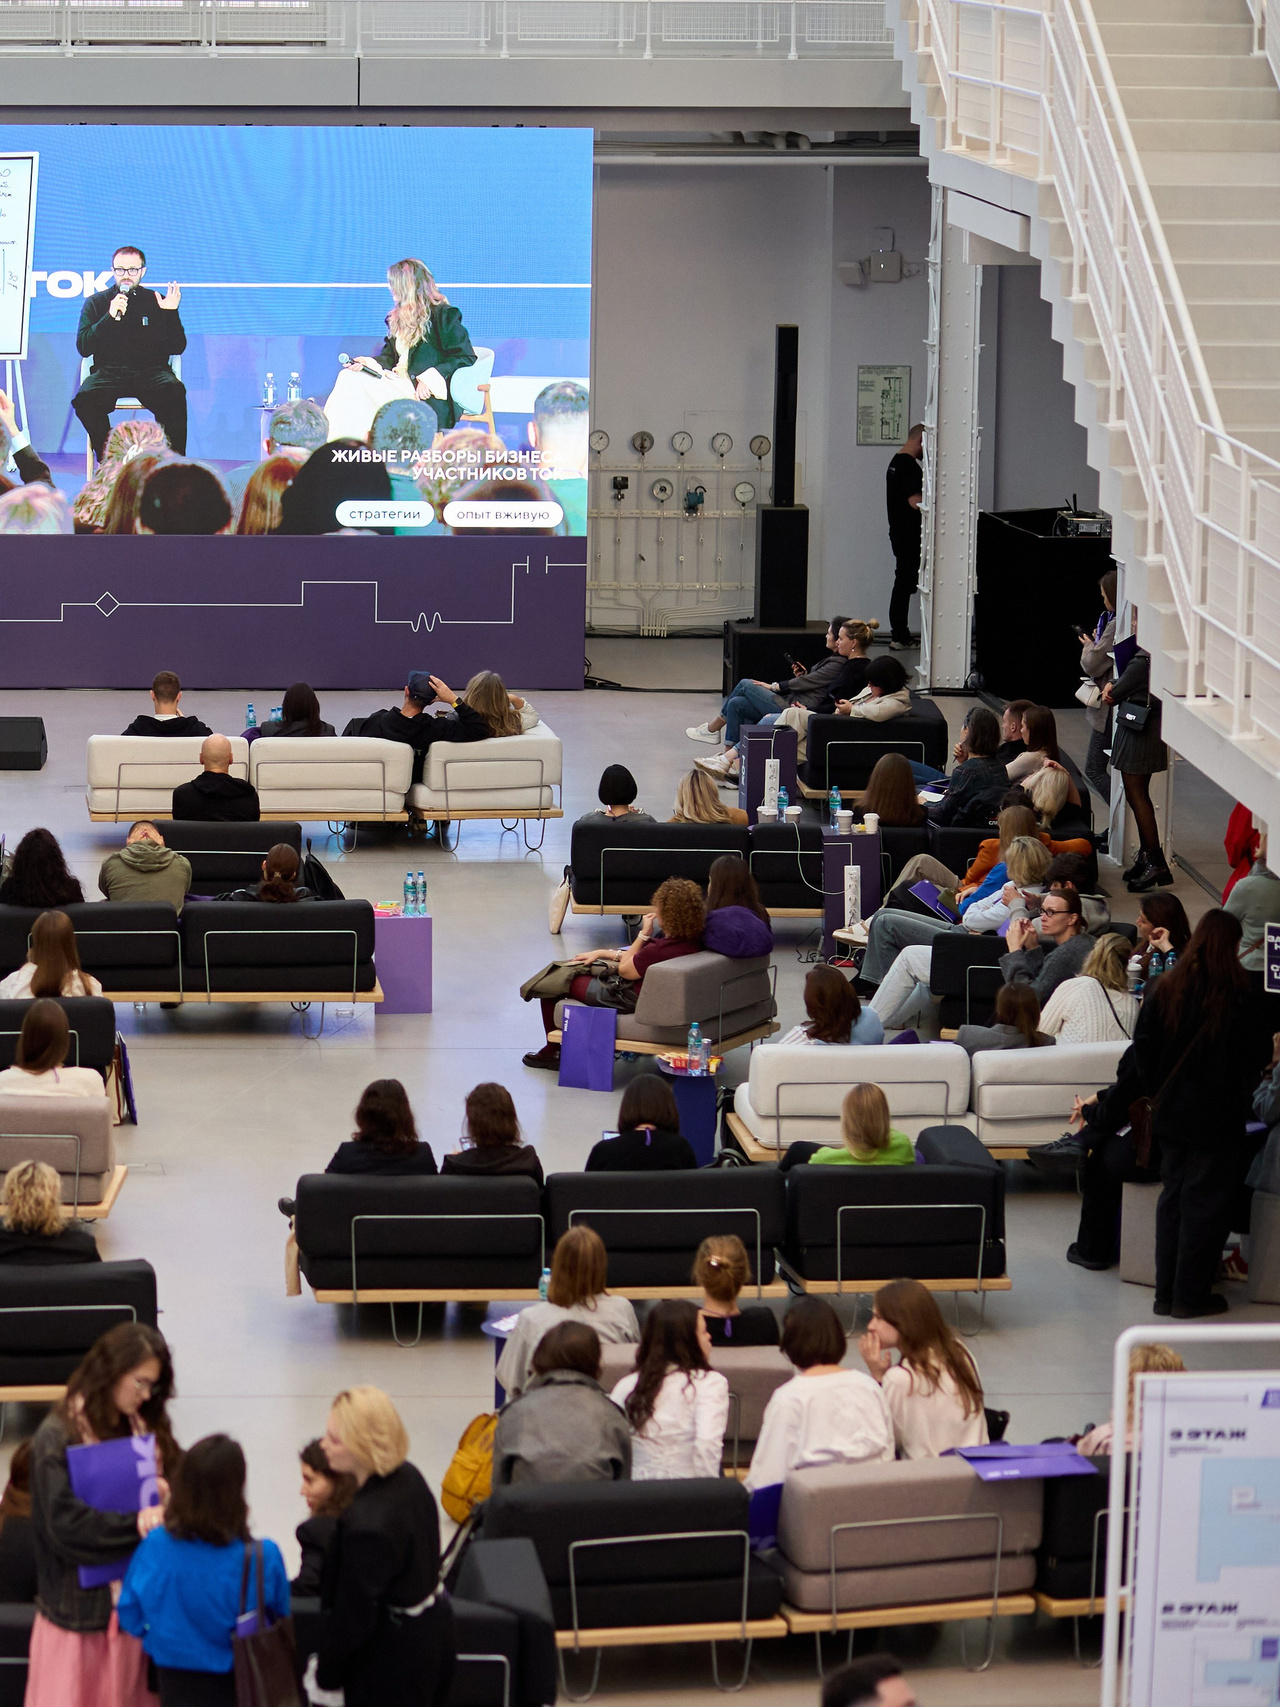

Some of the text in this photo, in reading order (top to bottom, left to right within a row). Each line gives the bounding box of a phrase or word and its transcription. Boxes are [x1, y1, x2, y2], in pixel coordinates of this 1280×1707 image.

[31, 270, 115, 298] ТОК
[331, 449, 398, 463] ЖИВЫЕ
[401, 449, 483, 463] РАЗБОРЫ
[412, 467, 528, 481] УЧАСТНИКОВ
[349, 509, 420, 521] стратегии
[456, 510, 550, 521] опыт вживую
